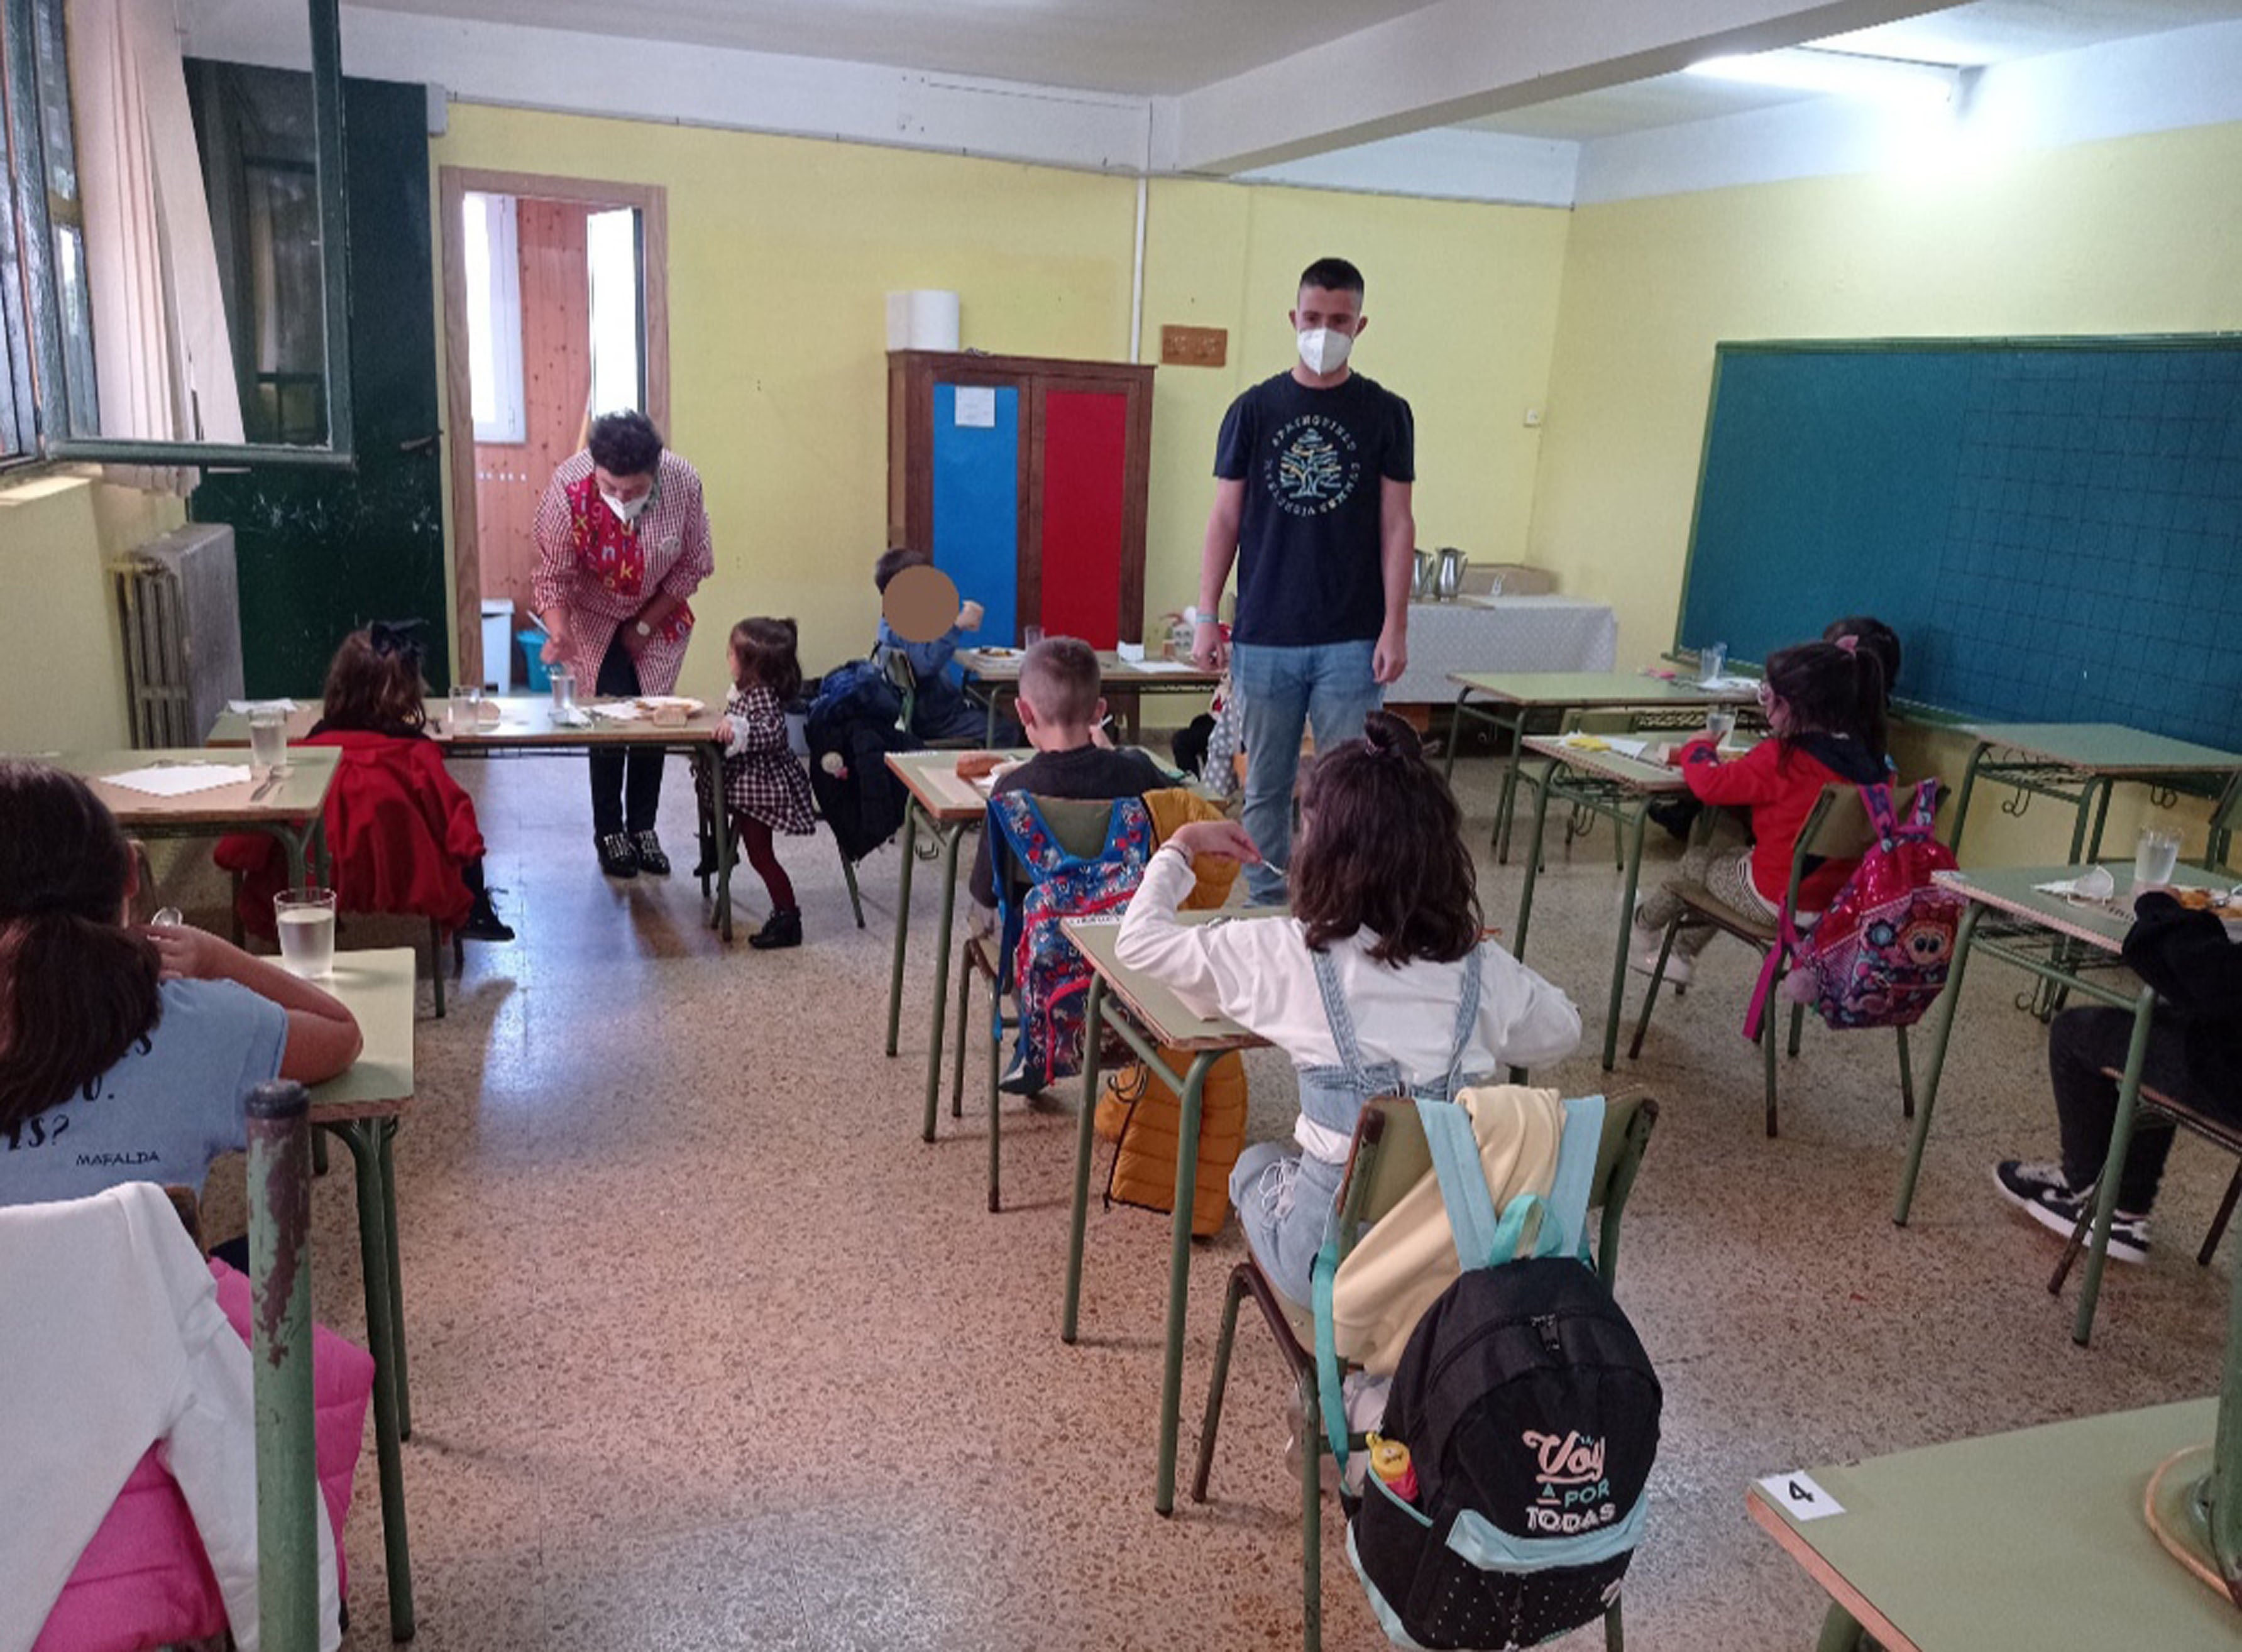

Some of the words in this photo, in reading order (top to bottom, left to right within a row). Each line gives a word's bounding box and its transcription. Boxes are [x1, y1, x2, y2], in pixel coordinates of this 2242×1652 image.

[76, 1151, 160, 1166] MAFALDA
[1522, 1430, 1606, 1484] Voy
[1542, 1483, 1556, 1497] A
[1564, 1477, 1610, 1508] POR
[1789, 1480, 1815, 1503] 4
[1525, 1502, 1617, 1533] TODAS
